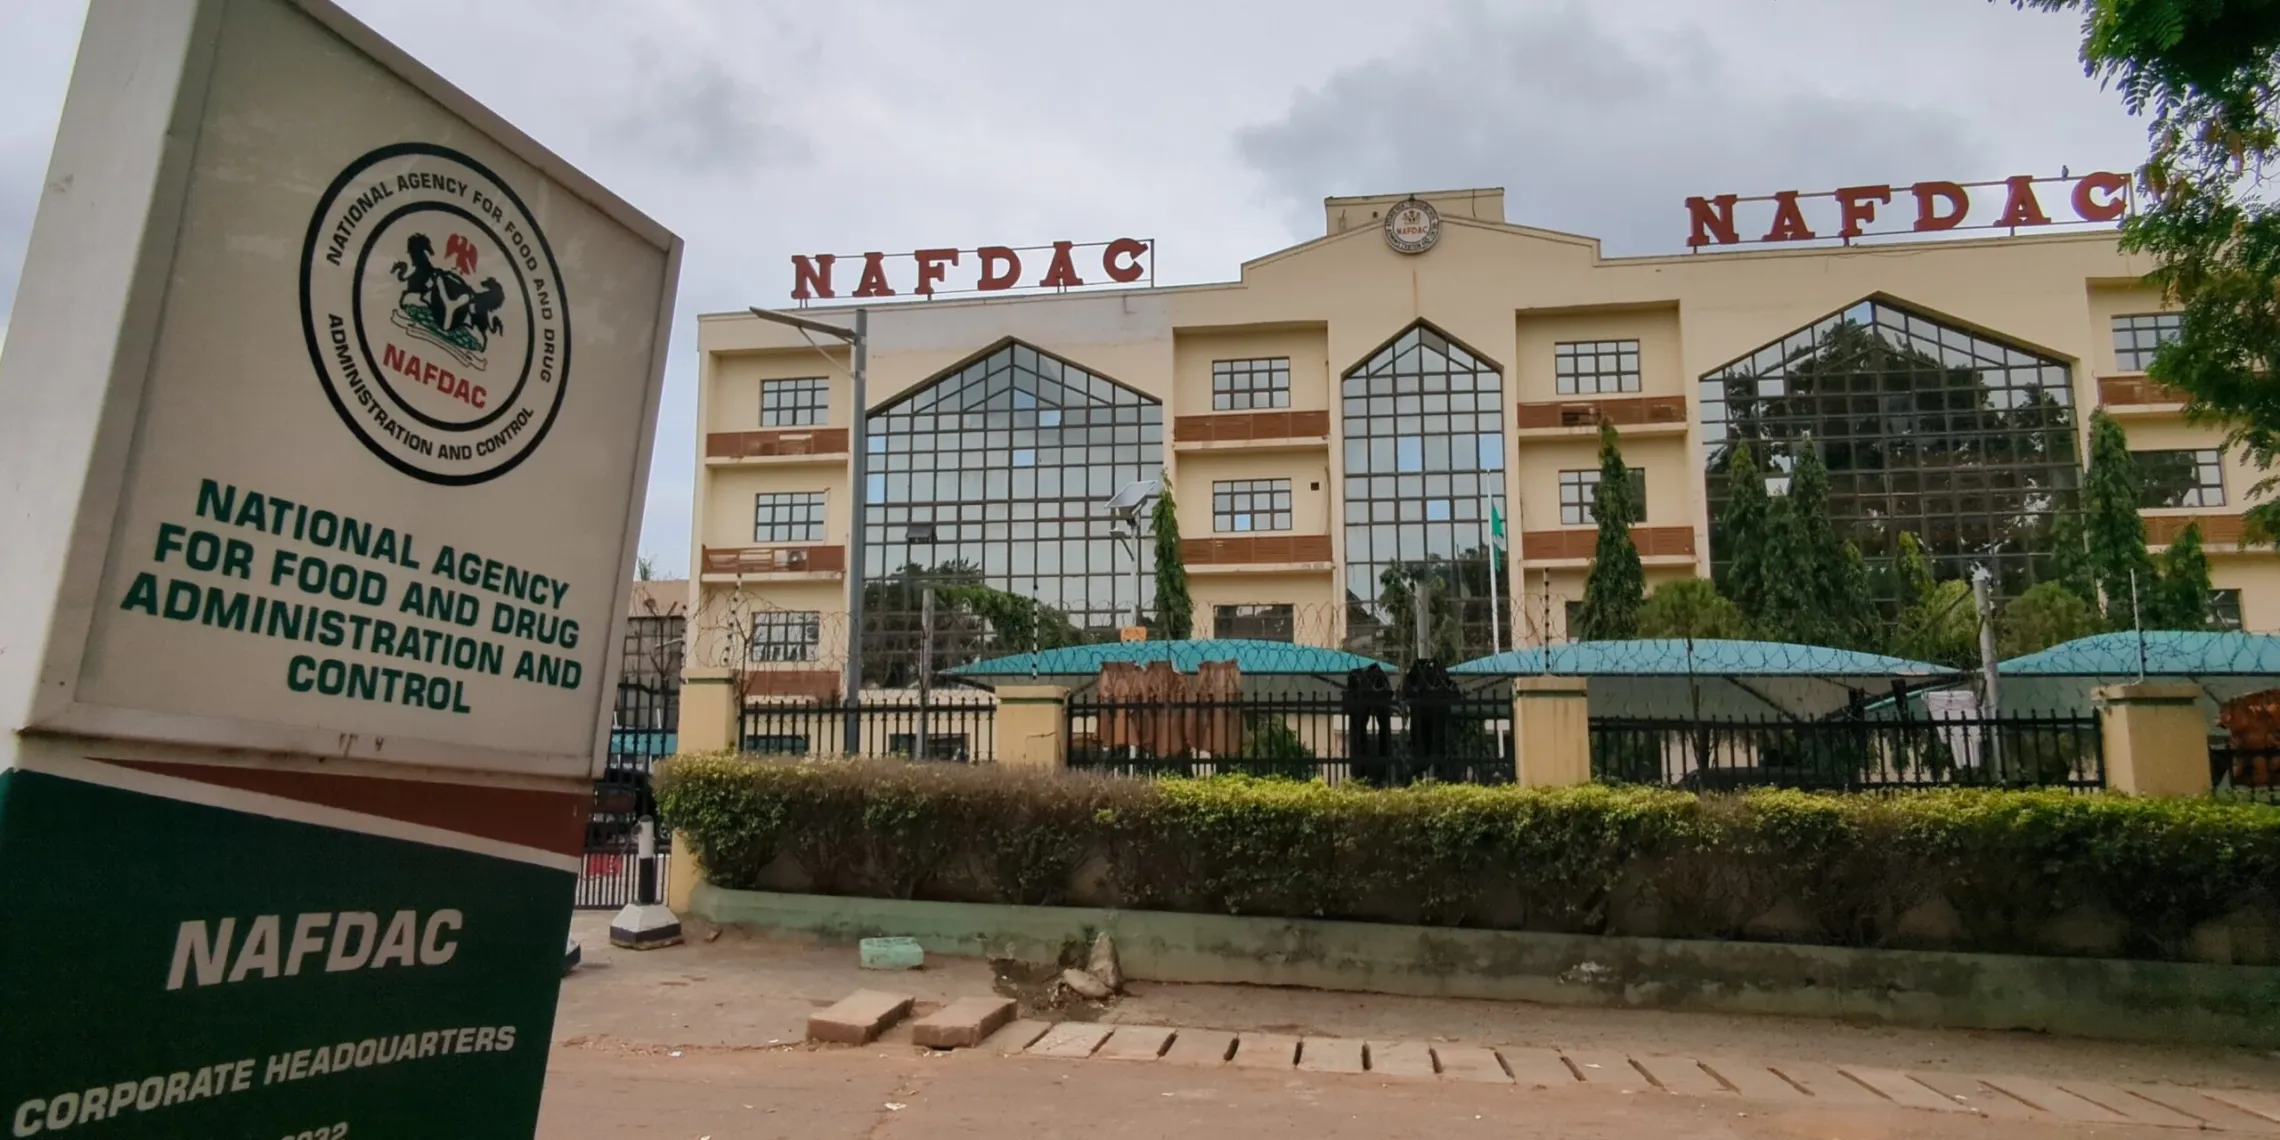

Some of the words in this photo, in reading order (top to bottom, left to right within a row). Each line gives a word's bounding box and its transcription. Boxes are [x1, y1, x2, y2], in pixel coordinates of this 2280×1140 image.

[397, 172, 468, 198] AGENCY
[472, 190, 504, 224] FOR
[1680, 170, 2128, 247] NAFDAC
[326, 182, 394, 267] NATIONAL
[504, 220, 539, 272] FOOD
[1396, 226, 1428, 235] NAFDAC
[533, 277, 554, 321] AND
[791, 237, 1149, 300] NAFDAC
[328, 313, 433, 457] ADMINISTRATION
[437, 444, 473, 461] AND
[476, 405, 535, 457] CONTROL
[382, 342, 489, 410] NAFDAC
[540, 328, 556, 384] DRUG
[195, 478, 420, 570] NATIONAL
[431, 544, 570, 610] AGENCY
[153, 522, 255, 581] FOR
[270, 548, 388, 607] FOOD
[399, 580, 480, 628] AND
[491, 600, 581, 650] DRUG
[119, 570, 505, 676] ADMINISTRATION
[512, 649, 583, 690] AND
[287, 654, 471, 715] CONTROL
[165, 907, 464, 991] NAFDAC
[12, 1058, 256, 1138] CORPORATE
[263, 1025, 517, 1086] HEADQUARTERS
